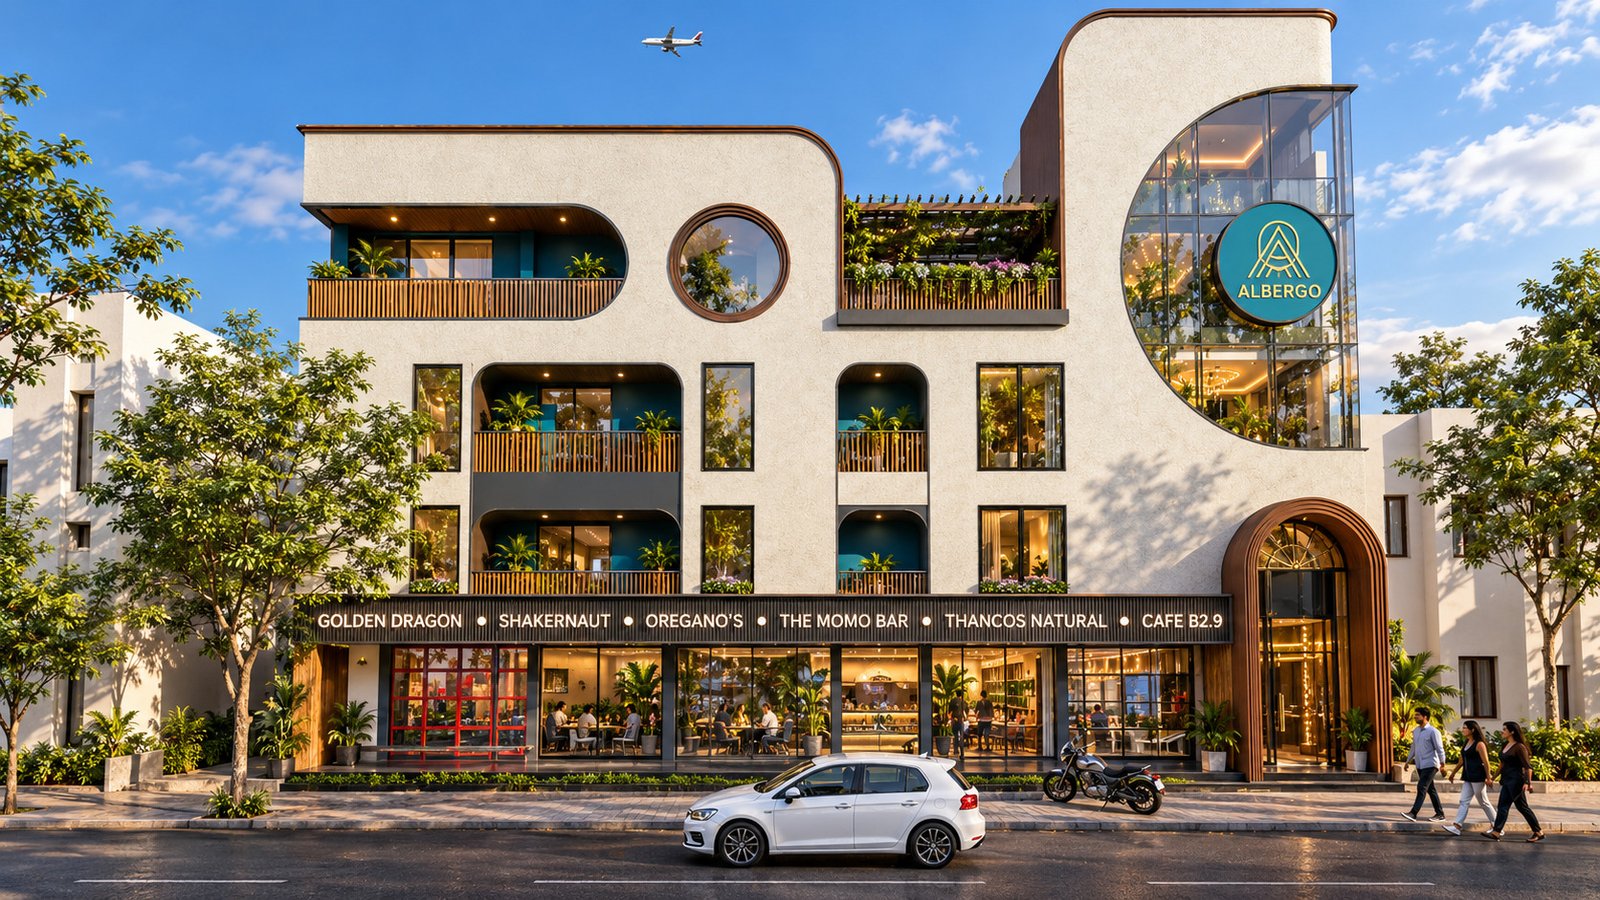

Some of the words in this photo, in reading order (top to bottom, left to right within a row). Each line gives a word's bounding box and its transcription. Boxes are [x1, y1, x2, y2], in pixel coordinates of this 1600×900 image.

[1238, 284, 1322, 299] ALBERGO
[317, 613, 386, 628] GOLDEN
[391, 613, 462, 628] DRAGON
[498, 613, 611, 628] SHAKERNAUT
[779, 613, 812, 628] THE
[816, 613, 871, 628] MOMO
[876, 613, 909, 628] BAR
[944, 613, 1027, 628] THANCOS
[1031, 613, 1108, 628] NATURAL
[1142, 613, 1184, 628] CAFE
[1189, 613, 1223, 628] B2.9
